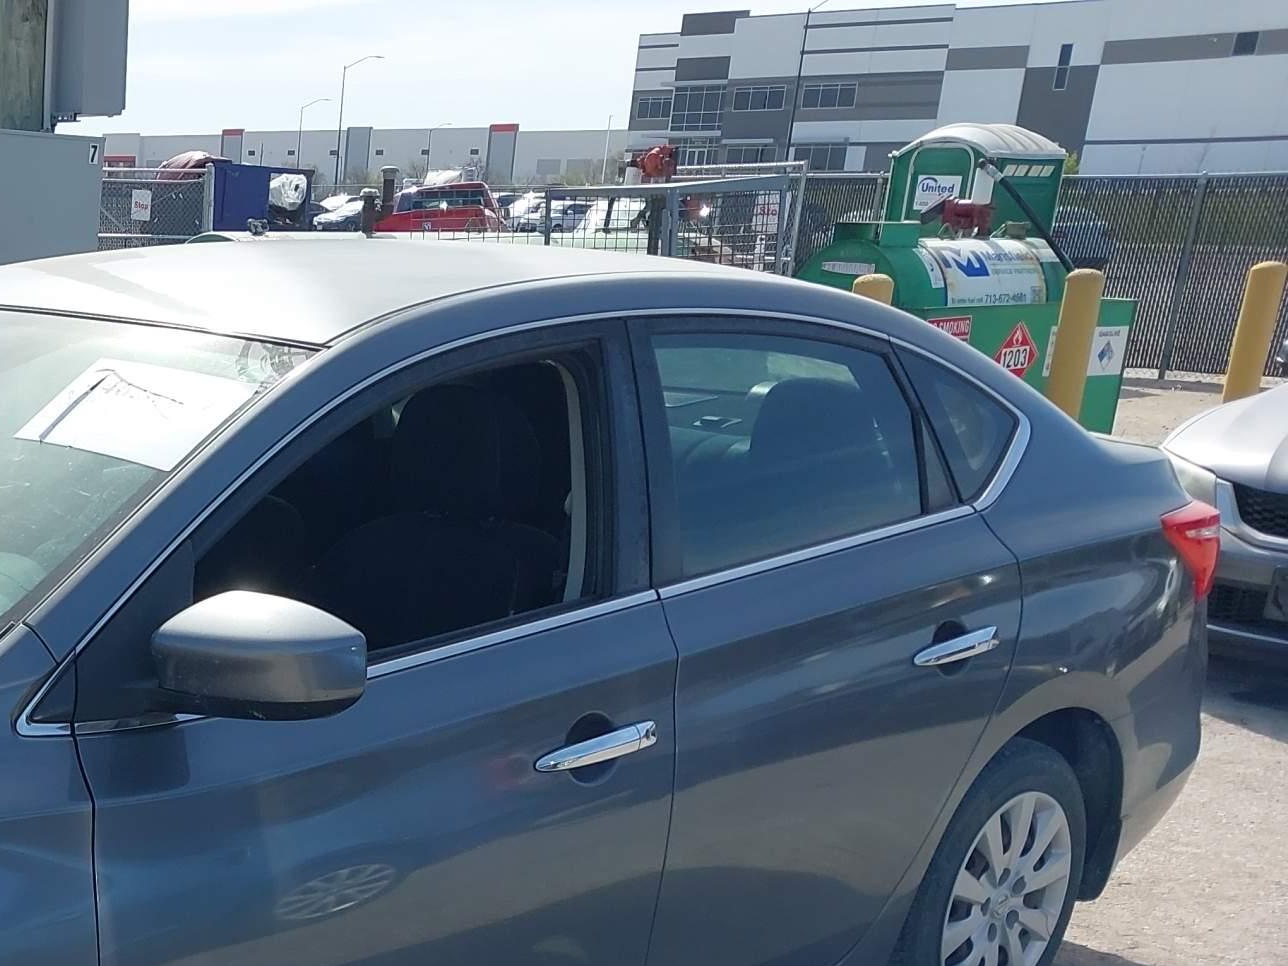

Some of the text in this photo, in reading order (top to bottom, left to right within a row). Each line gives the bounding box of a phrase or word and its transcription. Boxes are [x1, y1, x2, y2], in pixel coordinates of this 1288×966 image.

[90, 144, 98, 163] 7
[921, 182, 955, 194] United
[134, 201, 149, 209] Stop
[759, 206, 778, 216] Sto
[938, 319, 970, 335] SMOKING
[1002, 349, 1028, 369] 1203
